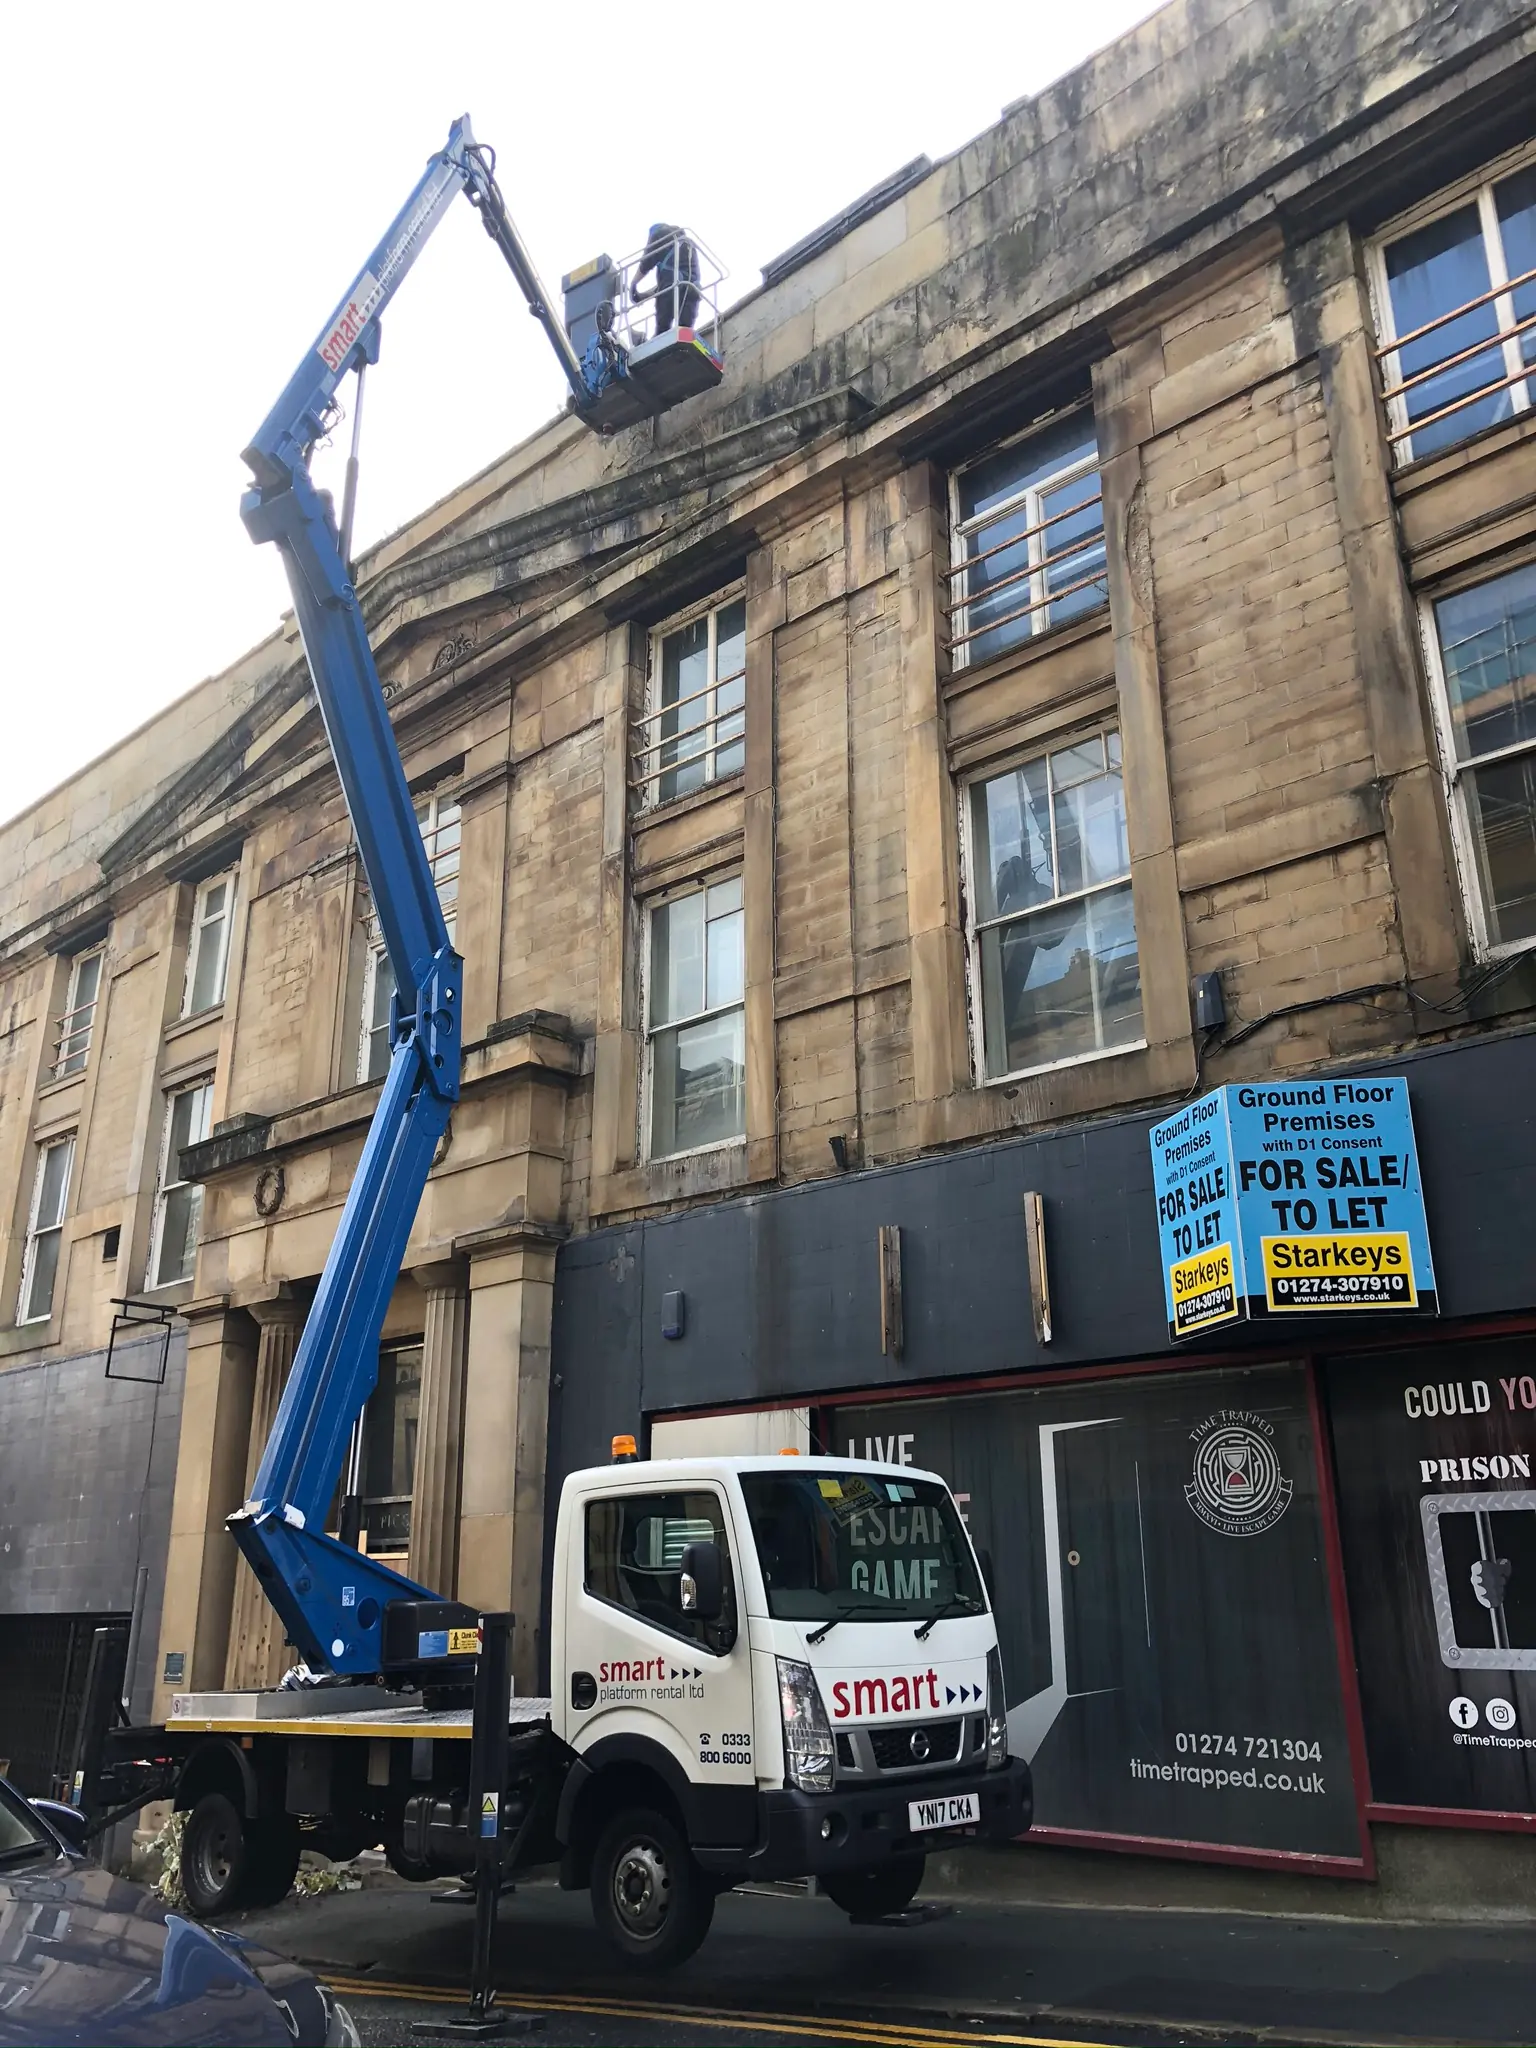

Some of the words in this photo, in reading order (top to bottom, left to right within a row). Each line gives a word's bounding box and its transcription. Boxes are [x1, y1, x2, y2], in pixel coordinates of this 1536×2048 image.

[322, 302, 366, 370] smart
[1238, 1085, 1326, 1108] Ground
[1334, 1083, 1394, 1104] Floor
[1155, 1112, 1190, 1147] Ground
[1192, 1099, 1219, 1126] Floor
[1263, 1112, 1375, 1133] Premises
[1165, 1130, 1211, 1167] Premises
[1262, 1139, 1293, 1152] with
[1297, 1138, 1316, 1151] D1
[1321, 1135, 1383, 1150] Consent
[1166, 1169, 1179, 1185] with
[1180, 1165, 1188, 1179] D1
[1189, 1151, 1216, 1173] Consent
[1239, 1158, 1307, 1192] FOR
[1317, 1154, 1410, 1190] SALE/
[1159, 1188, 1186, 1226] FOR
[1188, 1163, 1230, 1211] SALE/
[1271, 1198, 1318, 1231] TO
[1328, 1196, 1389, 1230] LET
[1173, 1224, 1192, 1258] TO
[1195, 1209, 1221, 1249] LET
[1271, 1242, 1402, 1272] Starkeys
[1175, 1257, 1229, 1294] Starkeys
[1277, 1275, 1404, 1294] 01274-307910
[1178, 1286, 1231, 1317] 01274-307910
[1293, 1291, 1390, 1304] www.starkeys.co.uk
[1404, 1380, 1491, 1419] COULD
[1189, 1415, 1218, 1442] TIME
[1218, 1409, 1274, 1436] TRAPPED
[1419, 1454, 1531, 1484] PRISON
[1222, 1523, 1240, 1532] LIVE
[1241, 1520, 1267, 1532] ESCAPE
[1267, 1500, 1285, 1521] GAME
[851, 1558, 941, 1600] GAME
[600, 1656, 665, 1683] smart
[600, 1684, 647, 1703] platform
[650, 1684, 685, 1700] rental
[689, 1683, 704, 1698] ltd
[832, 1668, 940, 1718] smart
[722, 1733, 751, 1746] 0333
[1175, 1733, 1238, 1756] 01274
[1243, 1736, 1322, 1762] 721304
[700, 1751, 720, 1764] 800
[722, 1752, 752, 1765] 6000
[1129, 1758, 1325, 1794] timetrapped.co.uk
[917, 1801, 947, 1826] YN17
[949, 1797, 973, 1821] CKA
